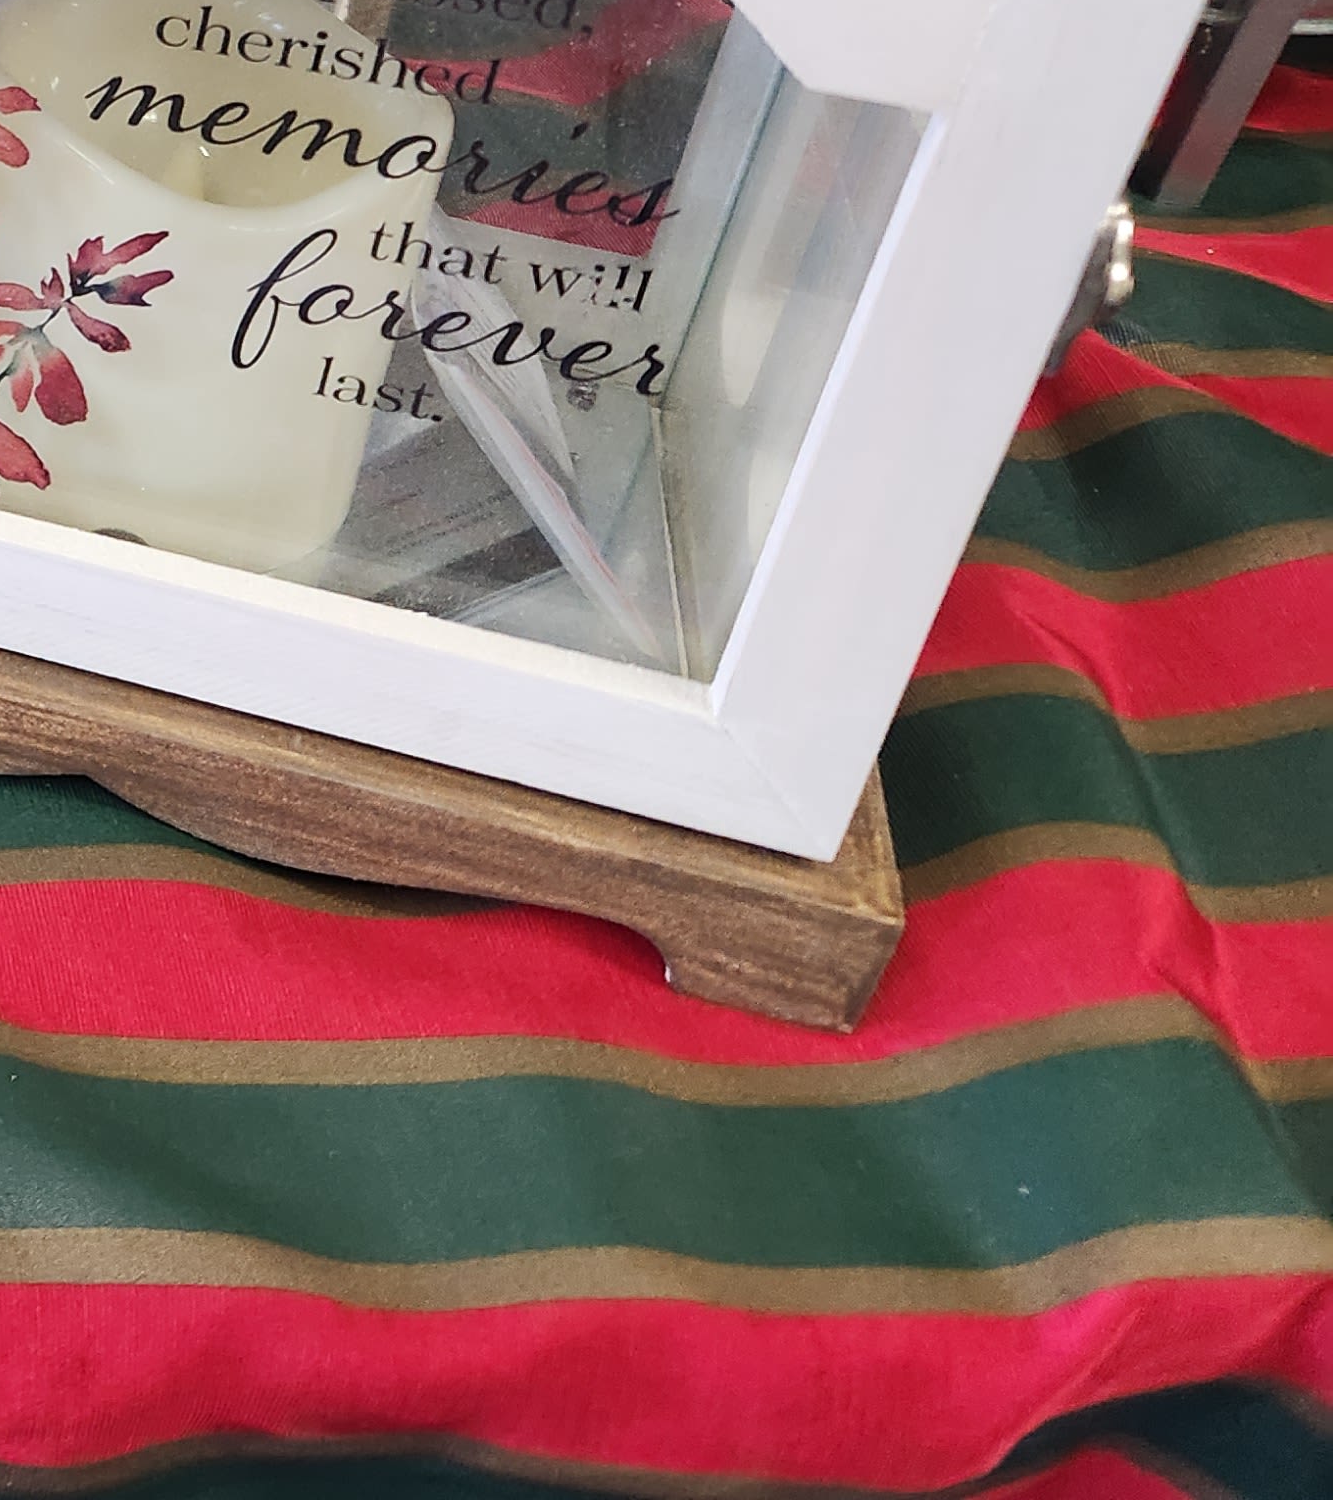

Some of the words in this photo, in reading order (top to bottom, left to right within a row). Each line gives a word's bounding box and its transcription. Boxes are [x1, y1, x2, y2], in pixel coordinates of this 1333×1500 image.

[155, 6, 501, 105] cherished
[85, 75, 681, 227] memories
[232, 228, 666, 397] forever
[369, 221, 508, 286] that
[528, 260, 655, 314] will
[312, 357, 444, 423] last.
